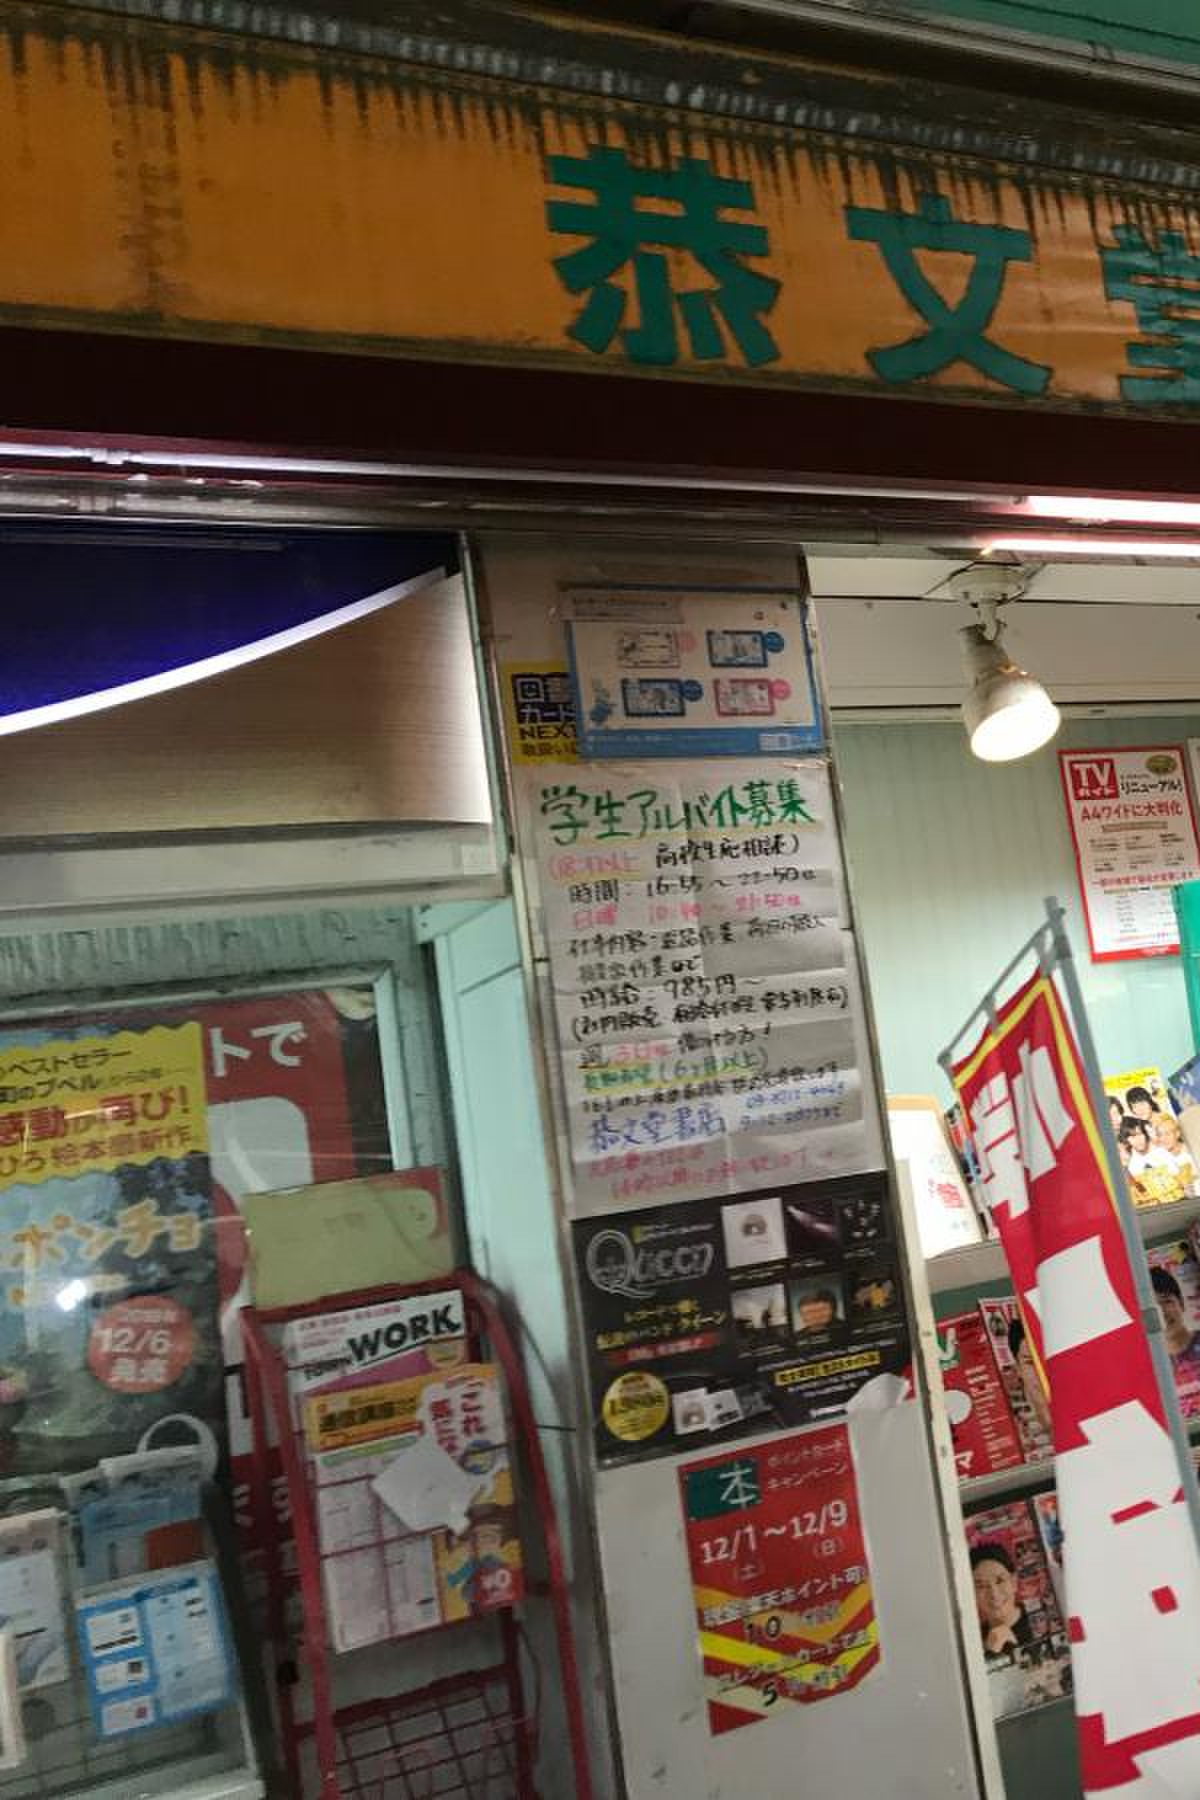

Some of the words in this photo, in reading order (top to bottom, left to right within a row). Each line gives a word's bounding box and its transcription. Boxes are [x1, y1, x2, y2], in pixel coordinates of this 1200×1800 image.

[1072, 762, 1110, 787] TV
[541, 778, 816, 845] 学生アルバイト募集
[95, 1328, 172, 1352] 12/6
[347, 1304, 461, 1361] WORK
[719, 1461, 759, 1510] 本
[762, 1682, 778, 1707] 5
